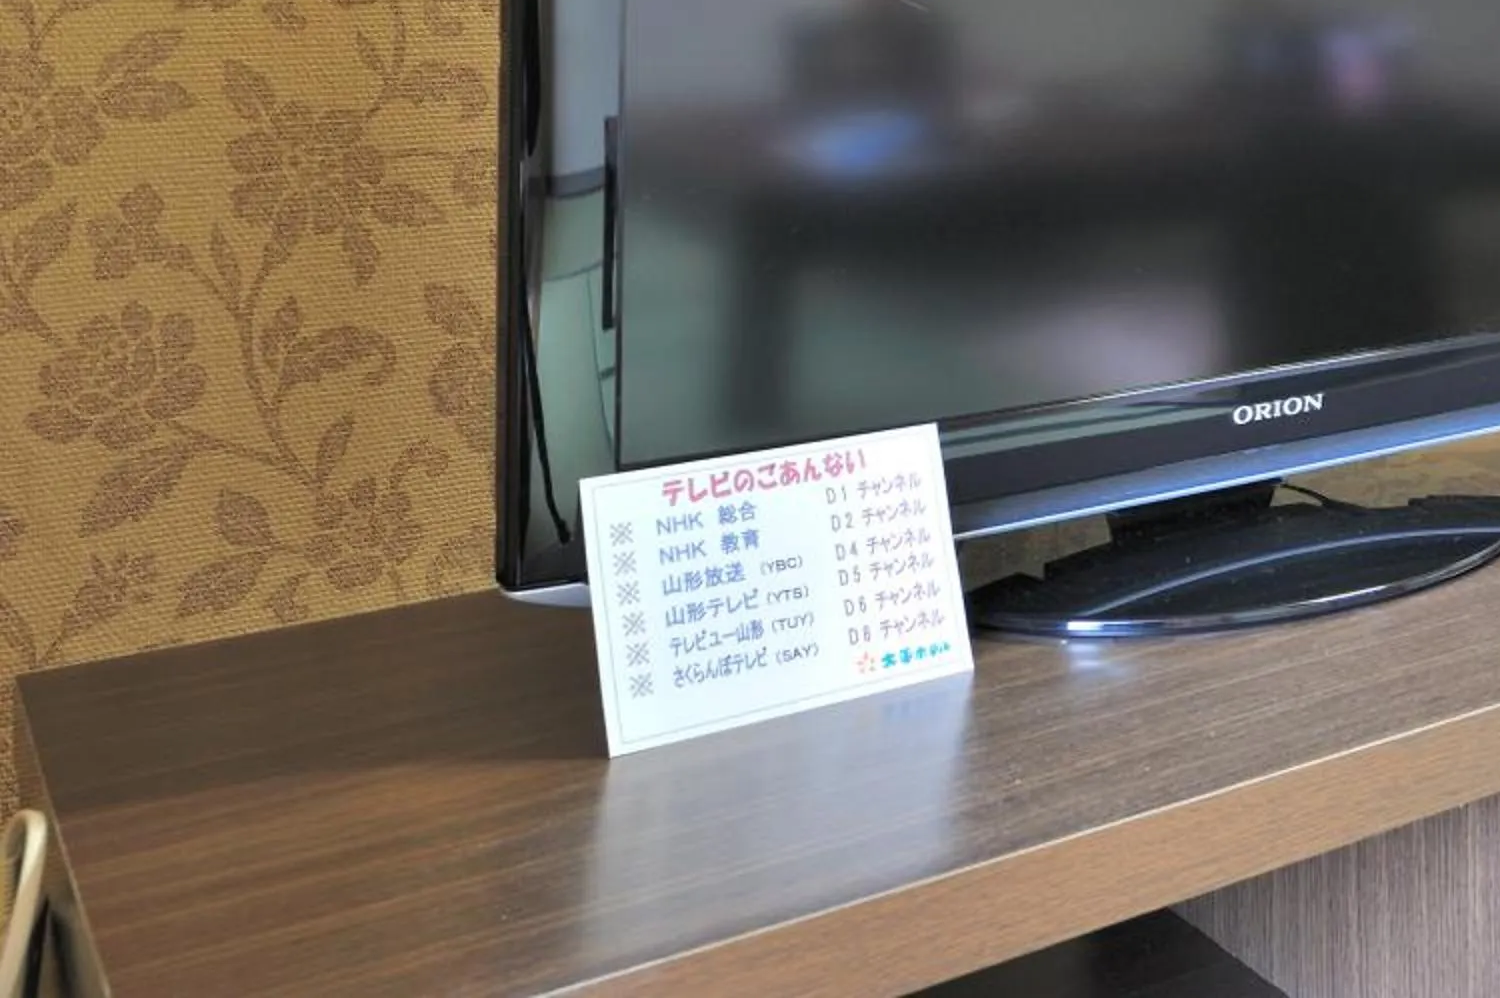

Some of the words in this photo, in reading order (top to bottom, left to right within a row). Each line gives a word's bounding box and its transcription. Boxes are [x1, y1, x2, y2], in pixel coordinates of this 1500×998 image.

[1233, 393, 1324, 424] ORION
[656, 512, 704, 535] NHK
[718, 500, 757, 525] 総合
[857, 473, 921, 500] チャンネル
[659, 540, 707, 564] NHK
[720, 529, 760, 554] 教育
[862, 498, 926, 527] チャンネル
[662, 561, 746, 595] 山形放送
[866, 528, 931, 555] チャンネル
[665, 588, 759, 627] 山形テレビ
[869, 552, 935, 581] チャンネル
[875, 580, 941, 611] チャンネル
[880, 608, 946, 639] チャンネル
